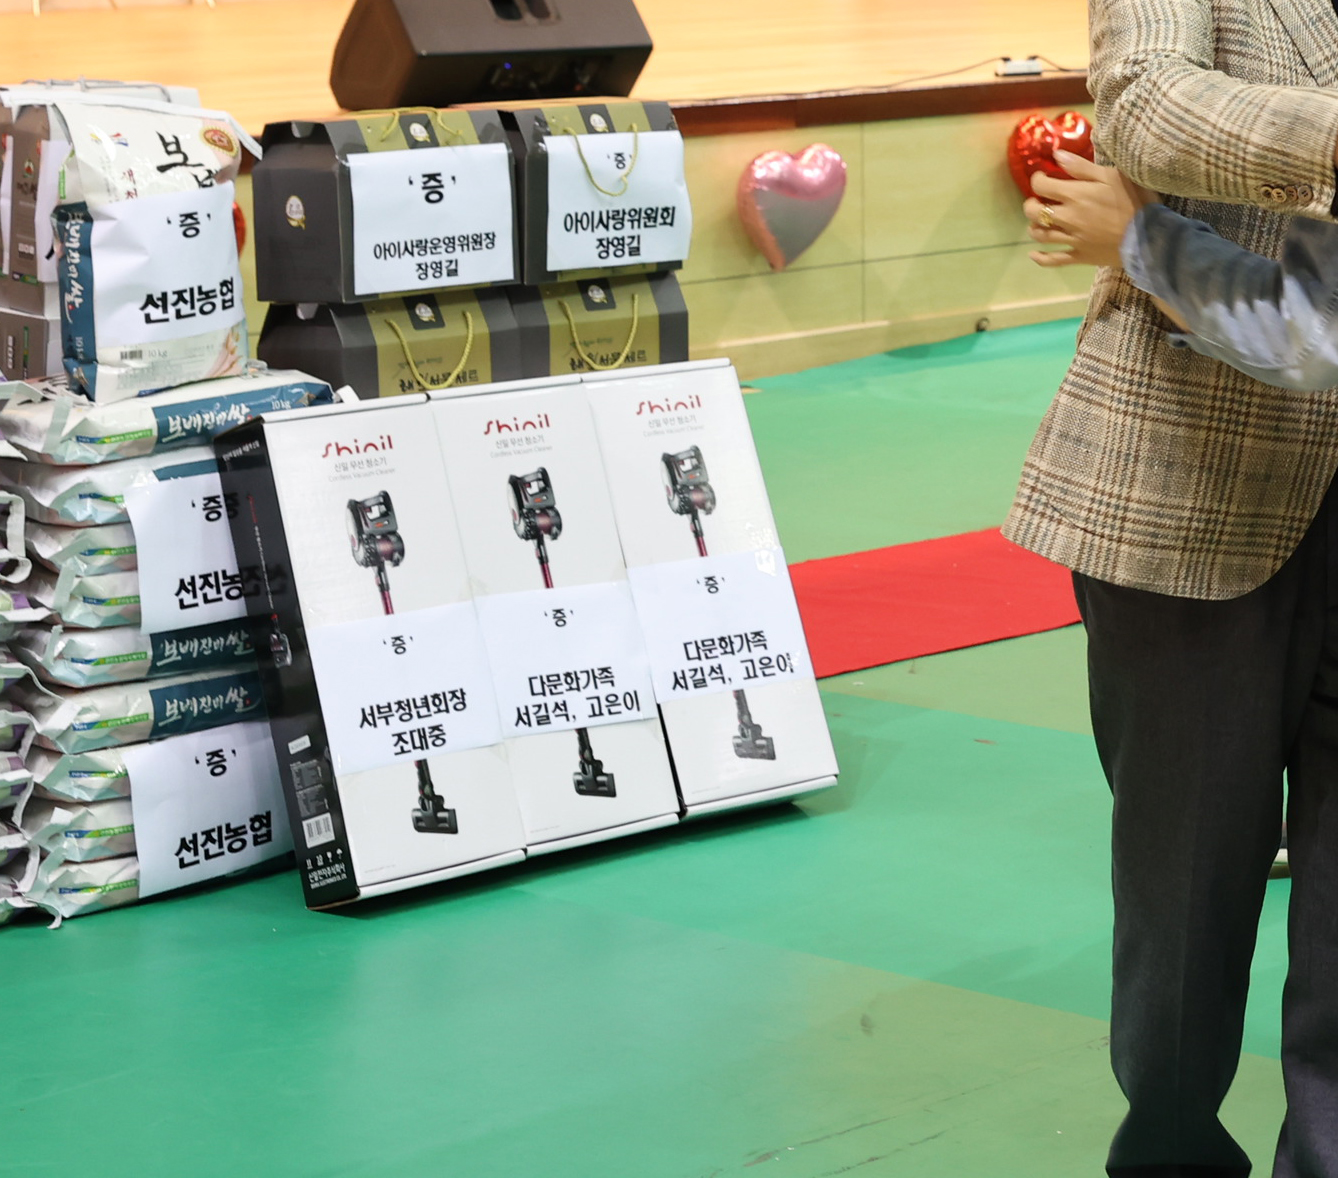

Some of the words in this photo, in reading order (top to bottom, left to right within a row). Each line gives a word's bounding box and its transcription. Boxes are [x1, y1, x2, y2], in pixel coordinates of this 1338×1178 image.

[563, 206, 676, 234] 아이사랑위원회
[373, 231, 497, 261] 아이사랑운영위원장
[595, 234, 642, 260] 장영길
[415, 258, 459, 281] 장영길
[139, 277, 235, 324] 선진농협
[683, 630, 768, 662] 다문화가족
[740, 652, 795, 681] 고은이
[528, 666, 615, 698] 다문화가족
[585, 689, 641, 719] 고은이
[391, 723, 447, 756] 조대중
[174, 810, 273, 870] 선진농협
